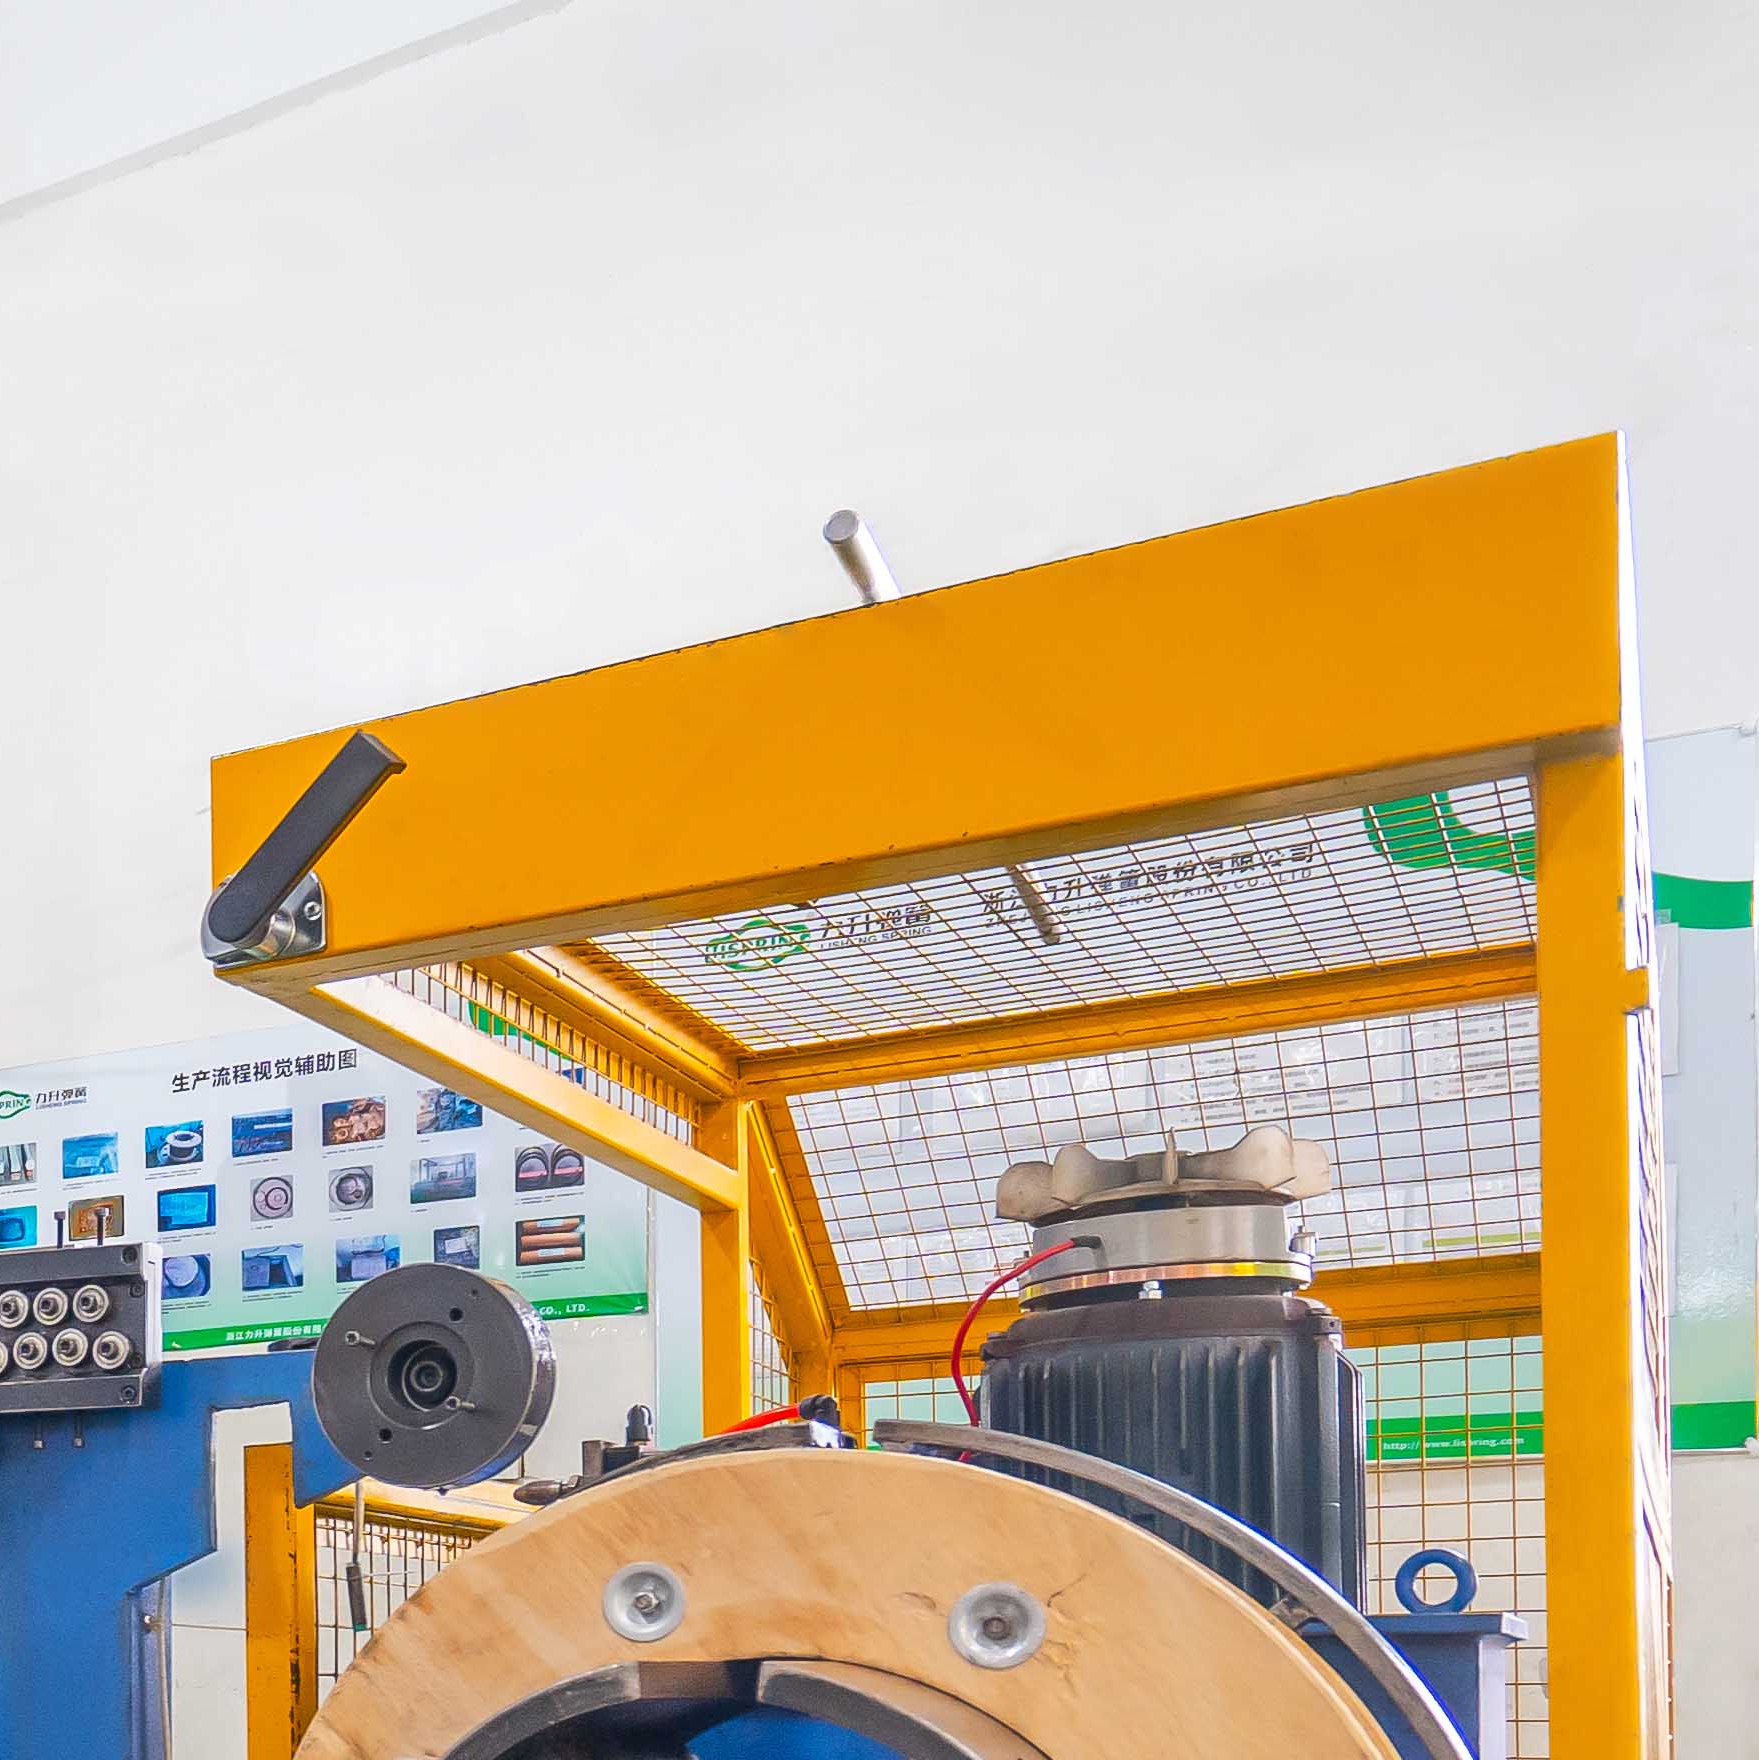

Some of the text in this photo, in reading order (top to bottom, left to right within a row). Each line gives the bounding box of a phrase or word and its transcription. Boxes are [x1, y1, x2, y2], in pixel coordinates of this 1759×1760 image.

[171, 1048, 357, 1094] 生产流程视觉辅助图
[35, 1086, 87, 1105] 力升弹簧
[539, 1303, 590, 1316] CO., LTD.
